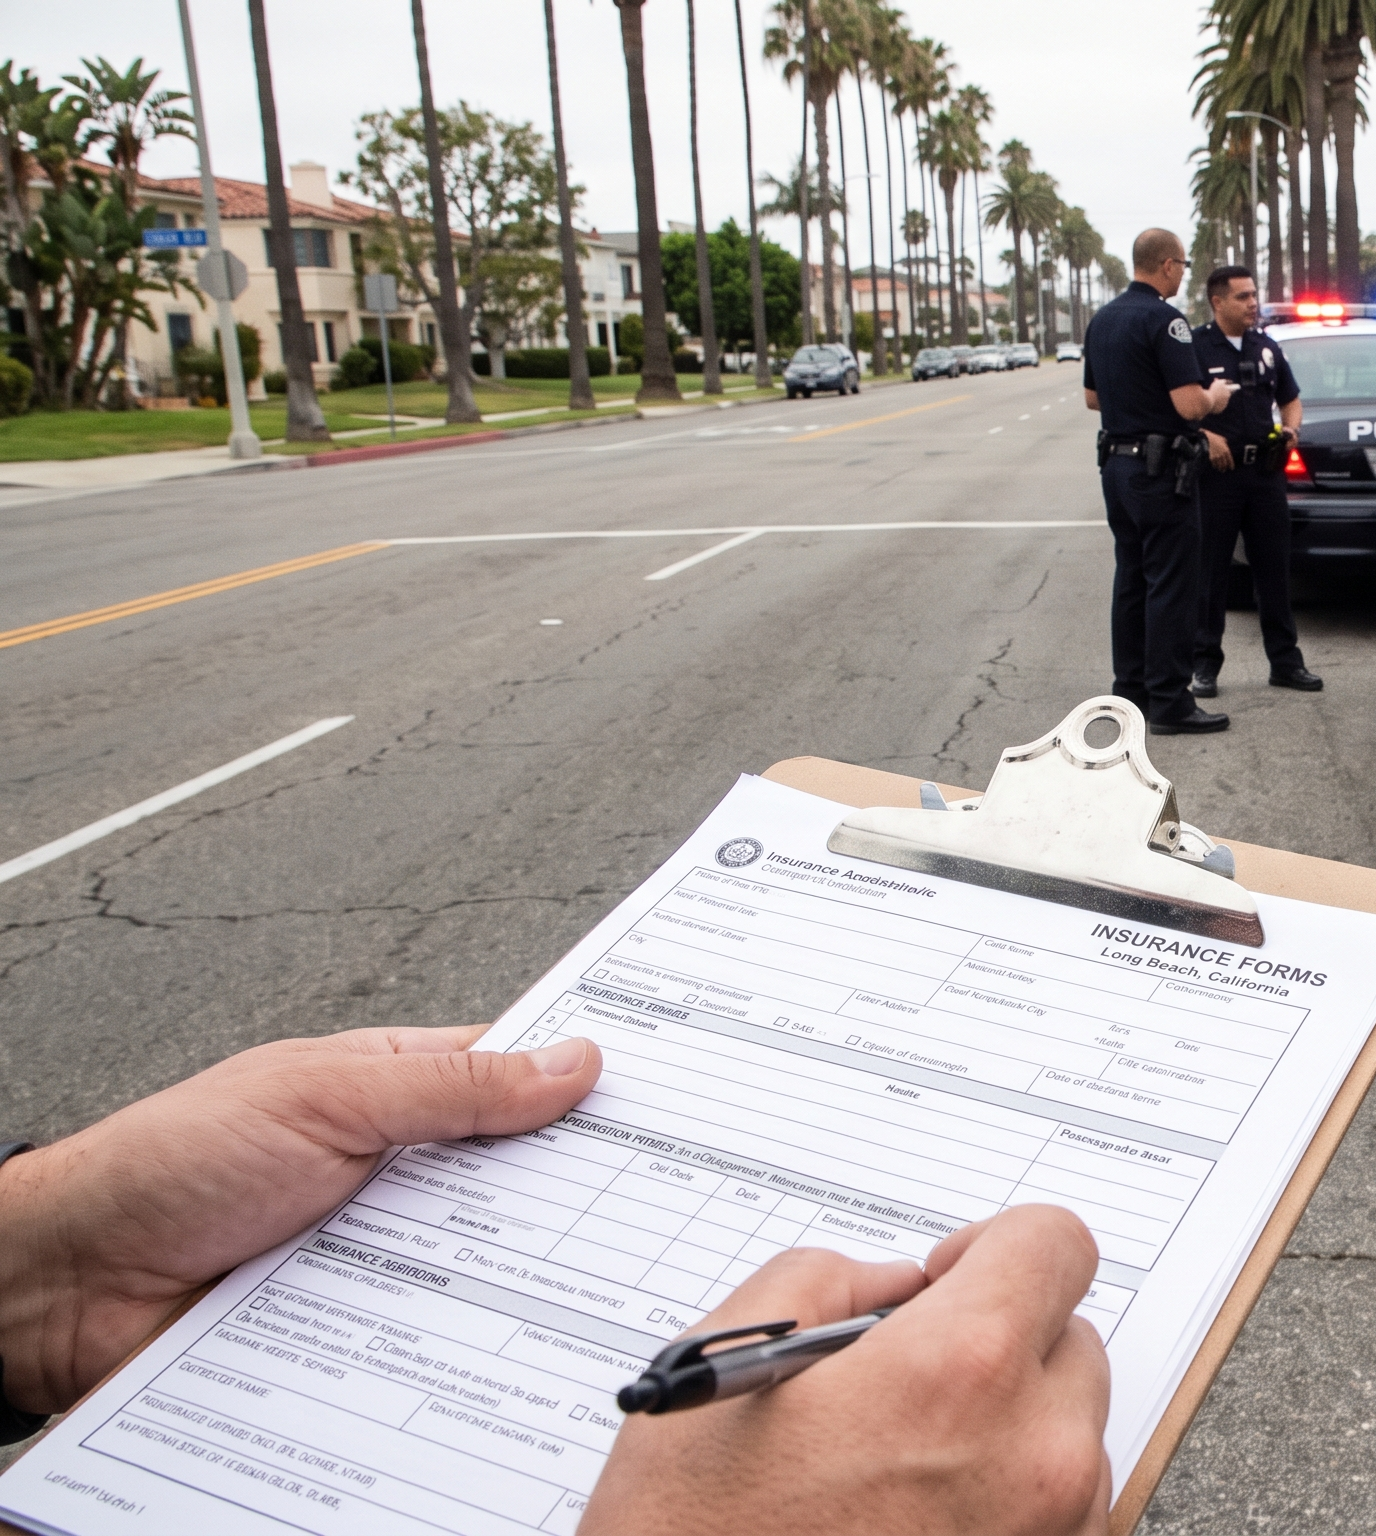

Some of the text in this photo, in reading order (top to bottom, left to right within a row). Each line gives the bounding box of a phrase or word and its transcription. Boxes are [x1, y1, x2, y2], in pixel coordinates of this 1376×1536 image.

[766, 851, 840, 876] Insurance
[1090, 923, 1328, 987] INSURANCE FORMS
[1100, 946, 1144, 966] Long
[1146, 957, 1201, 980] Beach,
[1208, 971, 1290, 997] California
[1072, 1079, 1087, 1087] of
[312, 1236, 382, 1266] INSURANCE
